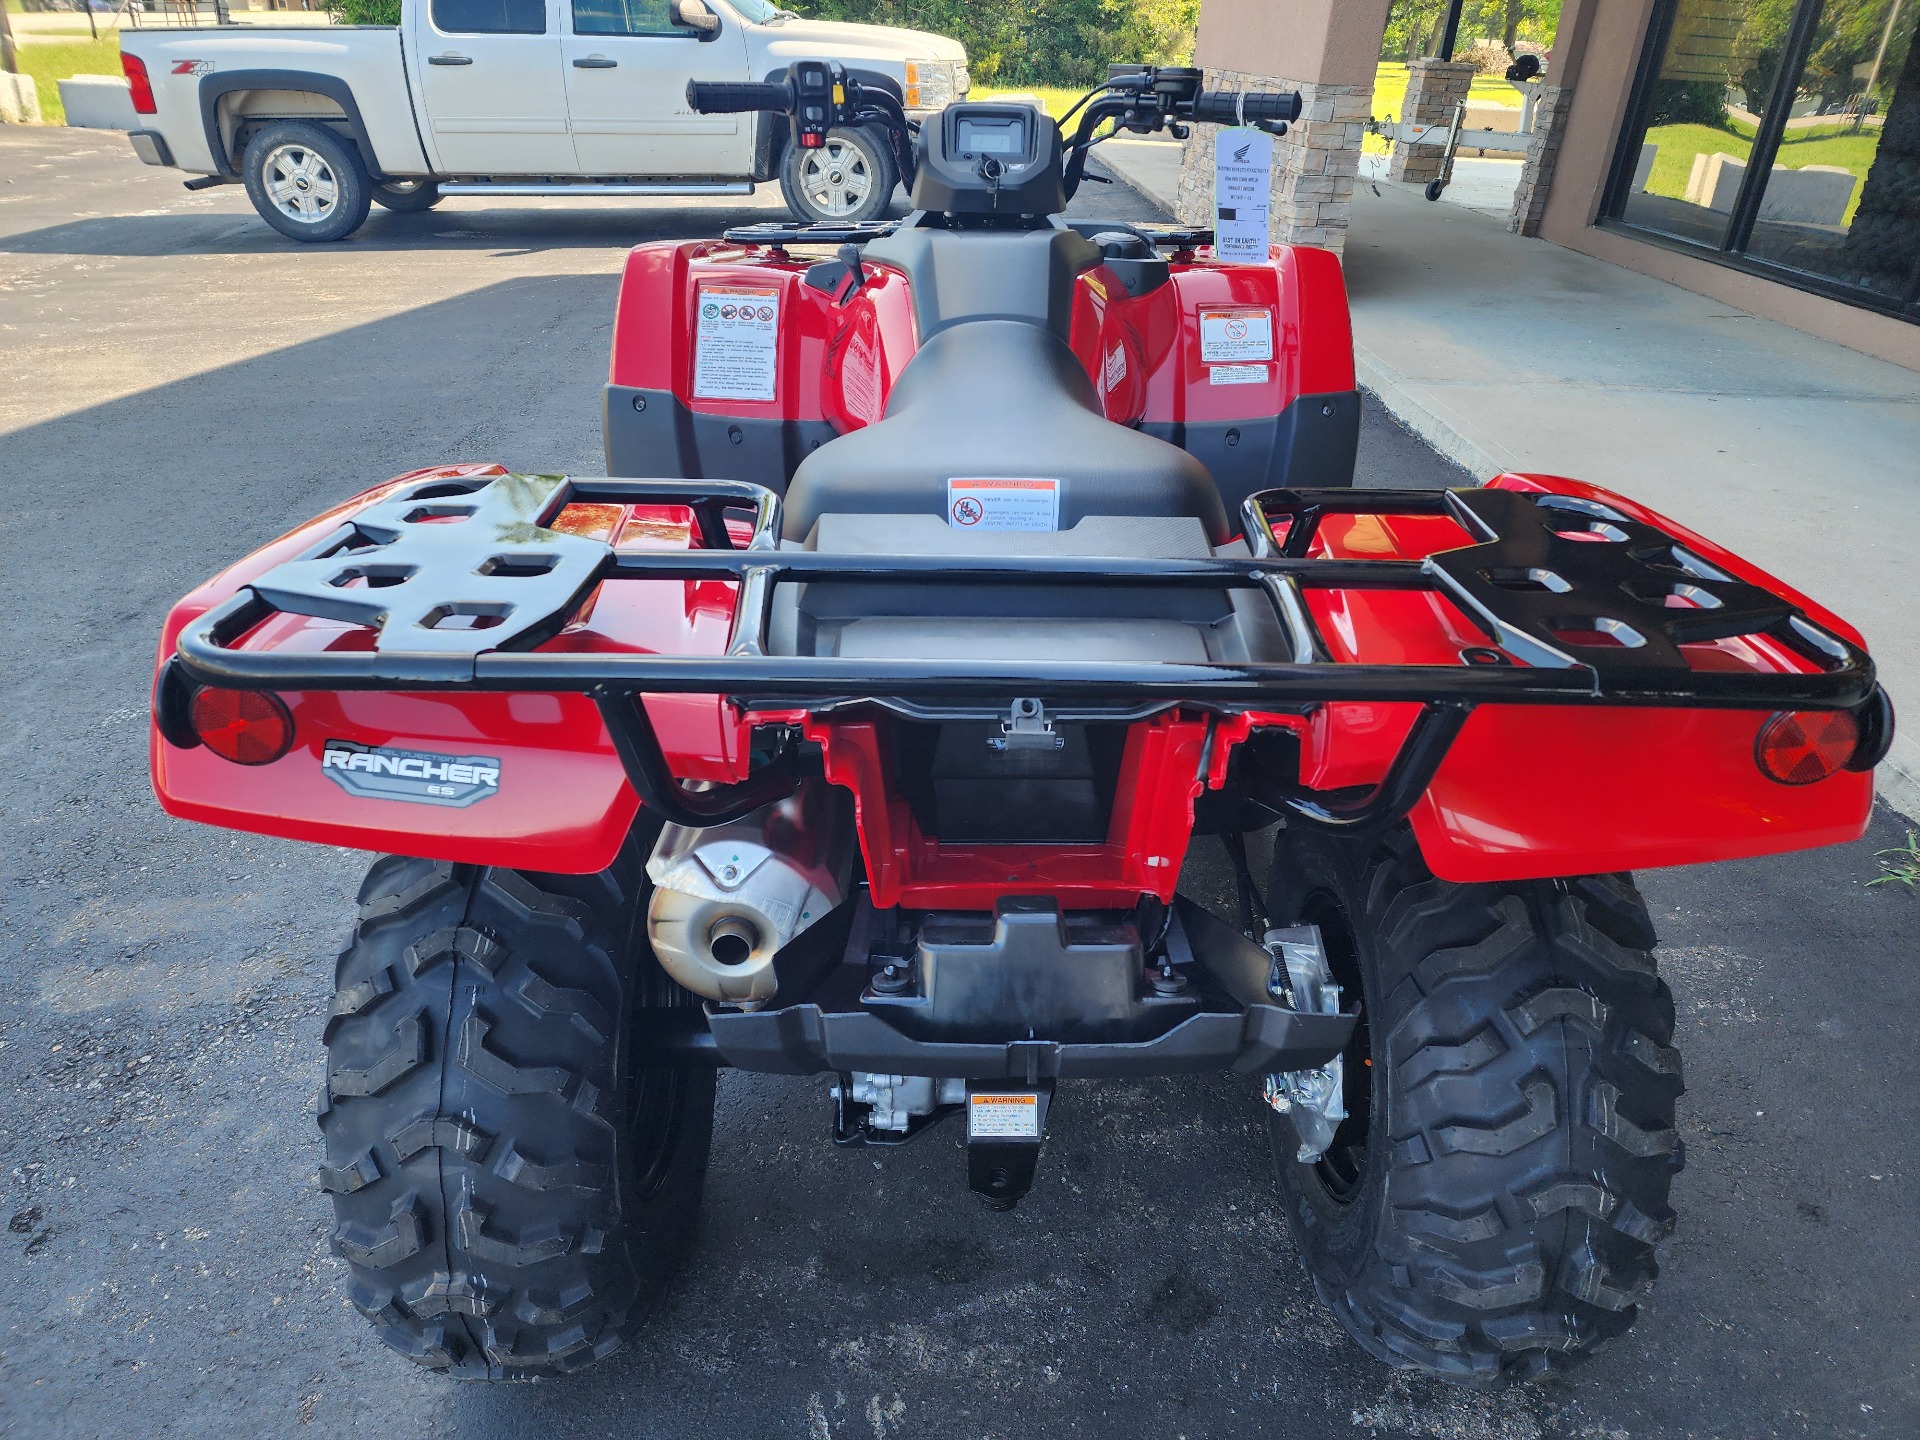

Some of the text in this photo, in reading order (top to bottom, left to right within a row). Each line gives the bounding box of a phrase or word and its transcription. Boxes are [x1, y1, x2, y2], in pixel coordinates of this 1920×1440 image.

[401, 752, 455, 763] INJECTION
[322, 749, 499, 787] RANCHER
[427, 784, 455, 796] ES
